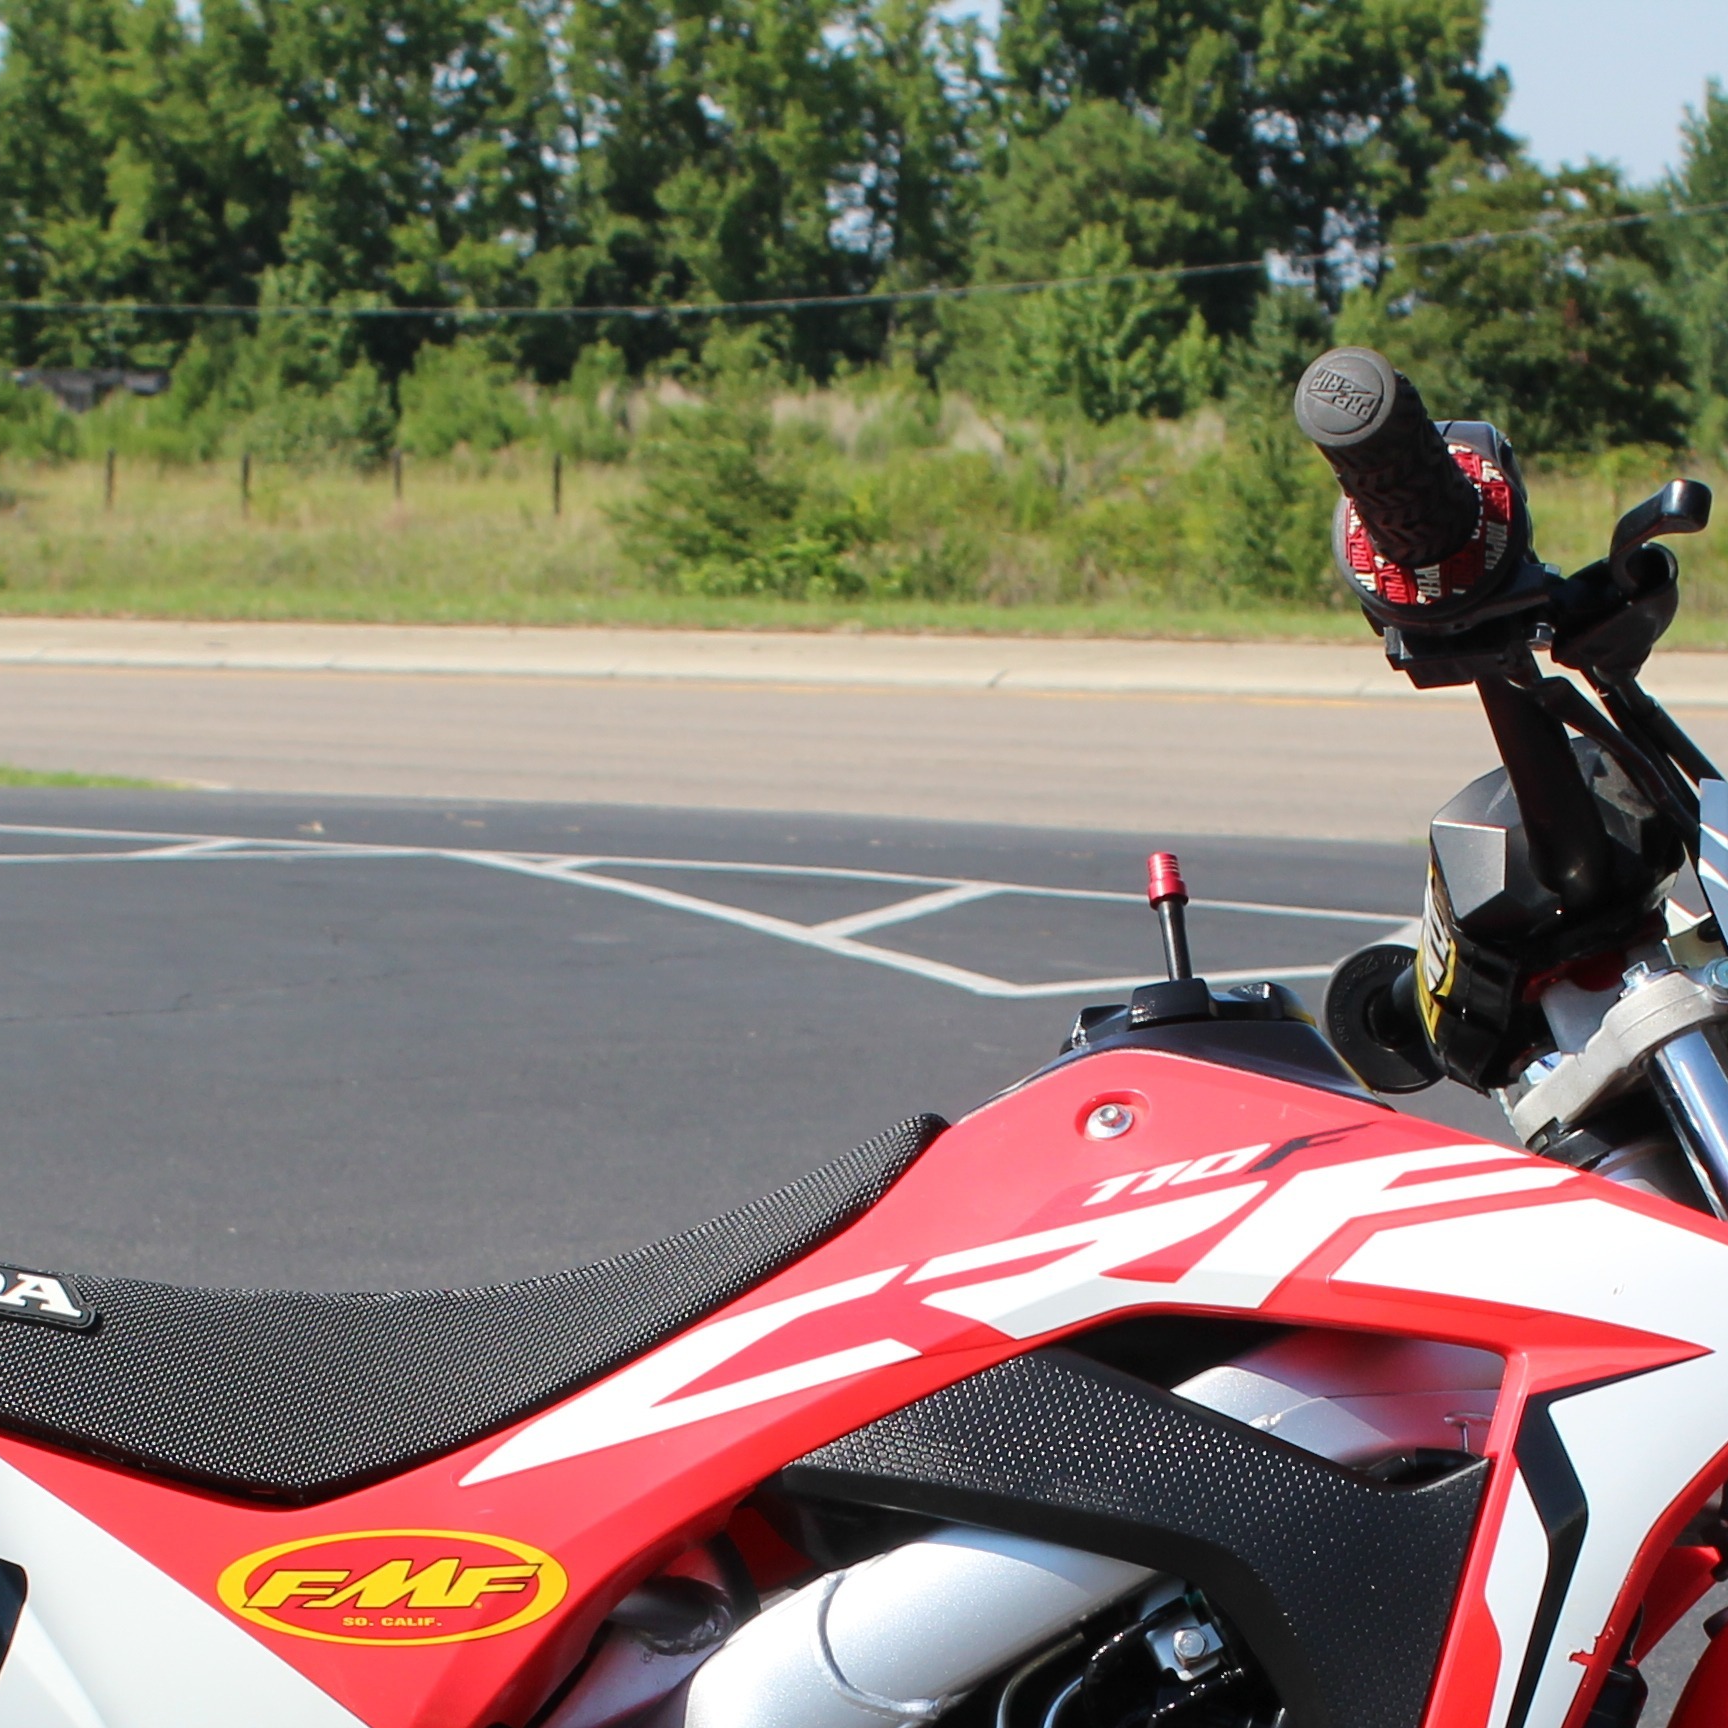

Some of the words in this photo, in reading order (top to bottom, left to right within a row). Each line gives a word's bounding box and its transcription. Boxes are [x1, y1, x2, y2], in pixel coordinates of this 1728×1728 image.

[1309, 369, 1353, 392] GRIP
[1333, 396, 1377, 421] PRO
[242, 1556, 544, 1610] FMF
[342, 1616, 375, 1627] SO.
[380, 1616, 443, 1627] CALIF.
